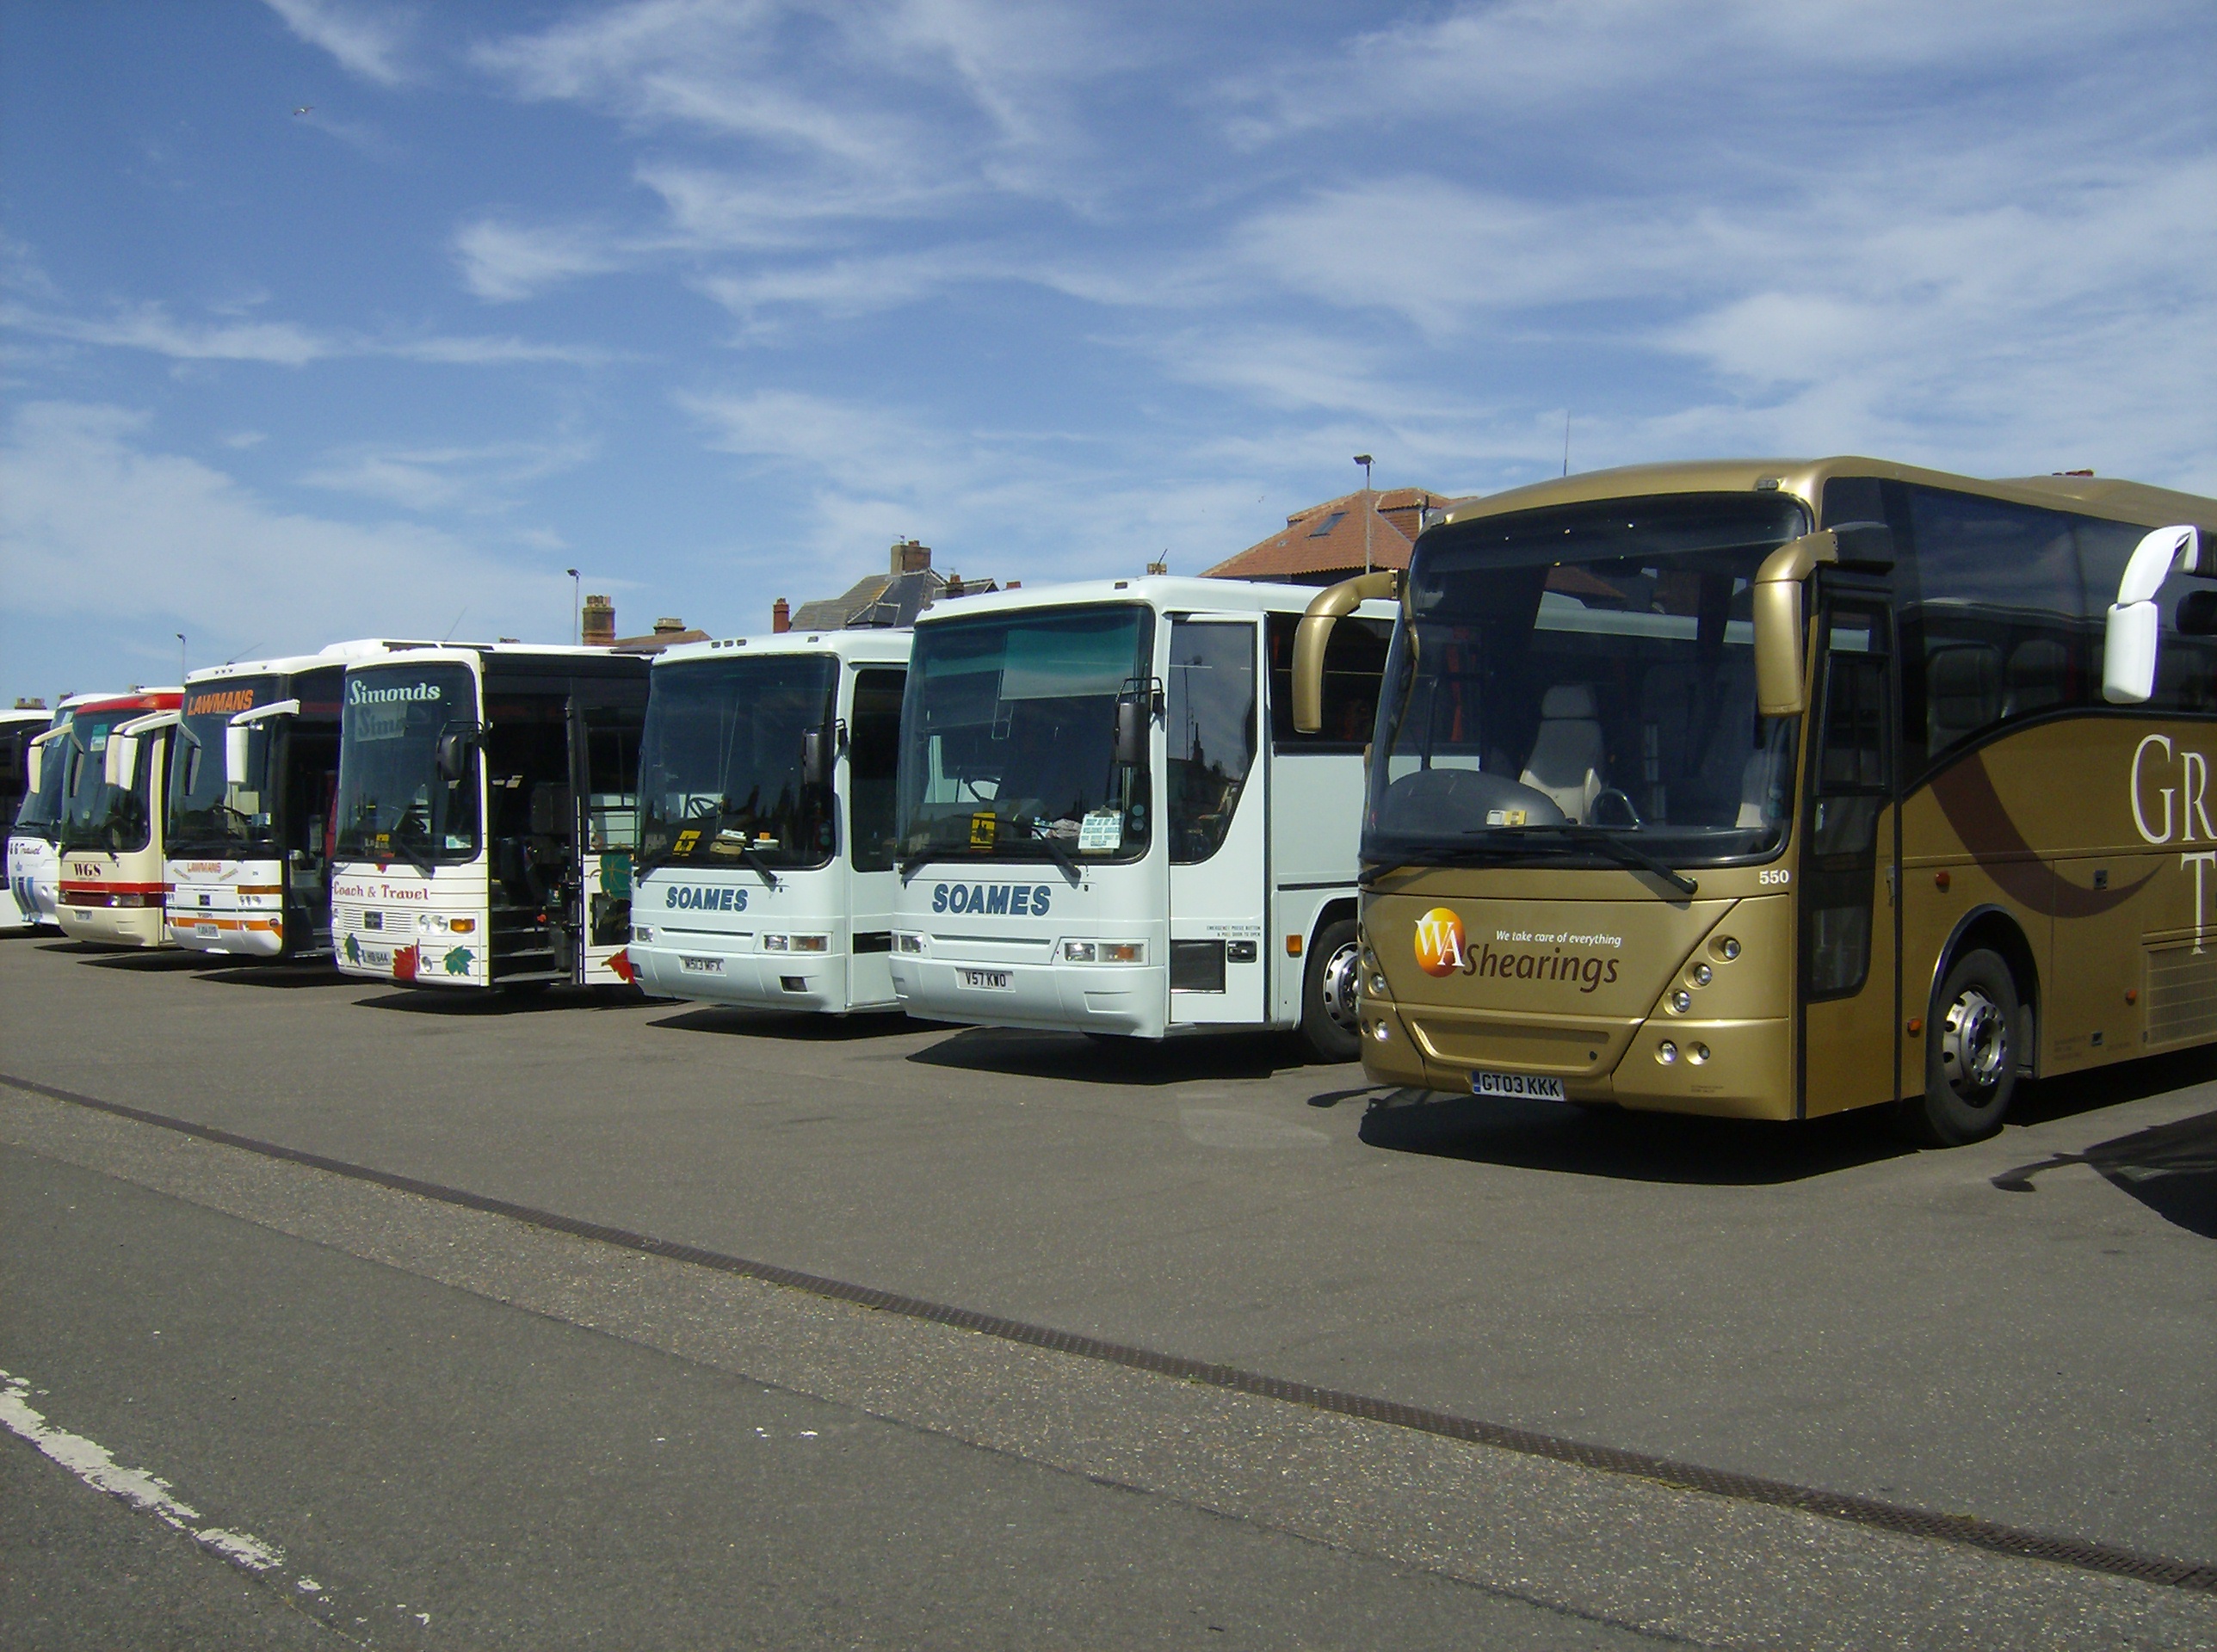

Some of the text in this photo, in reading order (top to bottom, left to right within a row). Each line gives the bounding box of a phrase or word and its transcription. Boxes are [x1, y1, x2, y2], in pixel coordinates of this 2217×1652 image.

[187, 689, 253, 716] LAWMANS
[349, 680, 441, 705] Simonds
[74, 863, 102, 876] WGS
[1759, 869, 1789, 885] 550
[334, 881, 429, 900] Coach & Travel
[666, 886, 749, 912] SOAMES
[932, 884, 1052, 916] SOAMES
[1496, 930, 1621, 948] We take care of everything
[965, 971, 1006, 987] V57 KWO
[1462, 944, 1620, 994] Shearings
[1482, 1074, 1560, 1097] GT03 KKK
